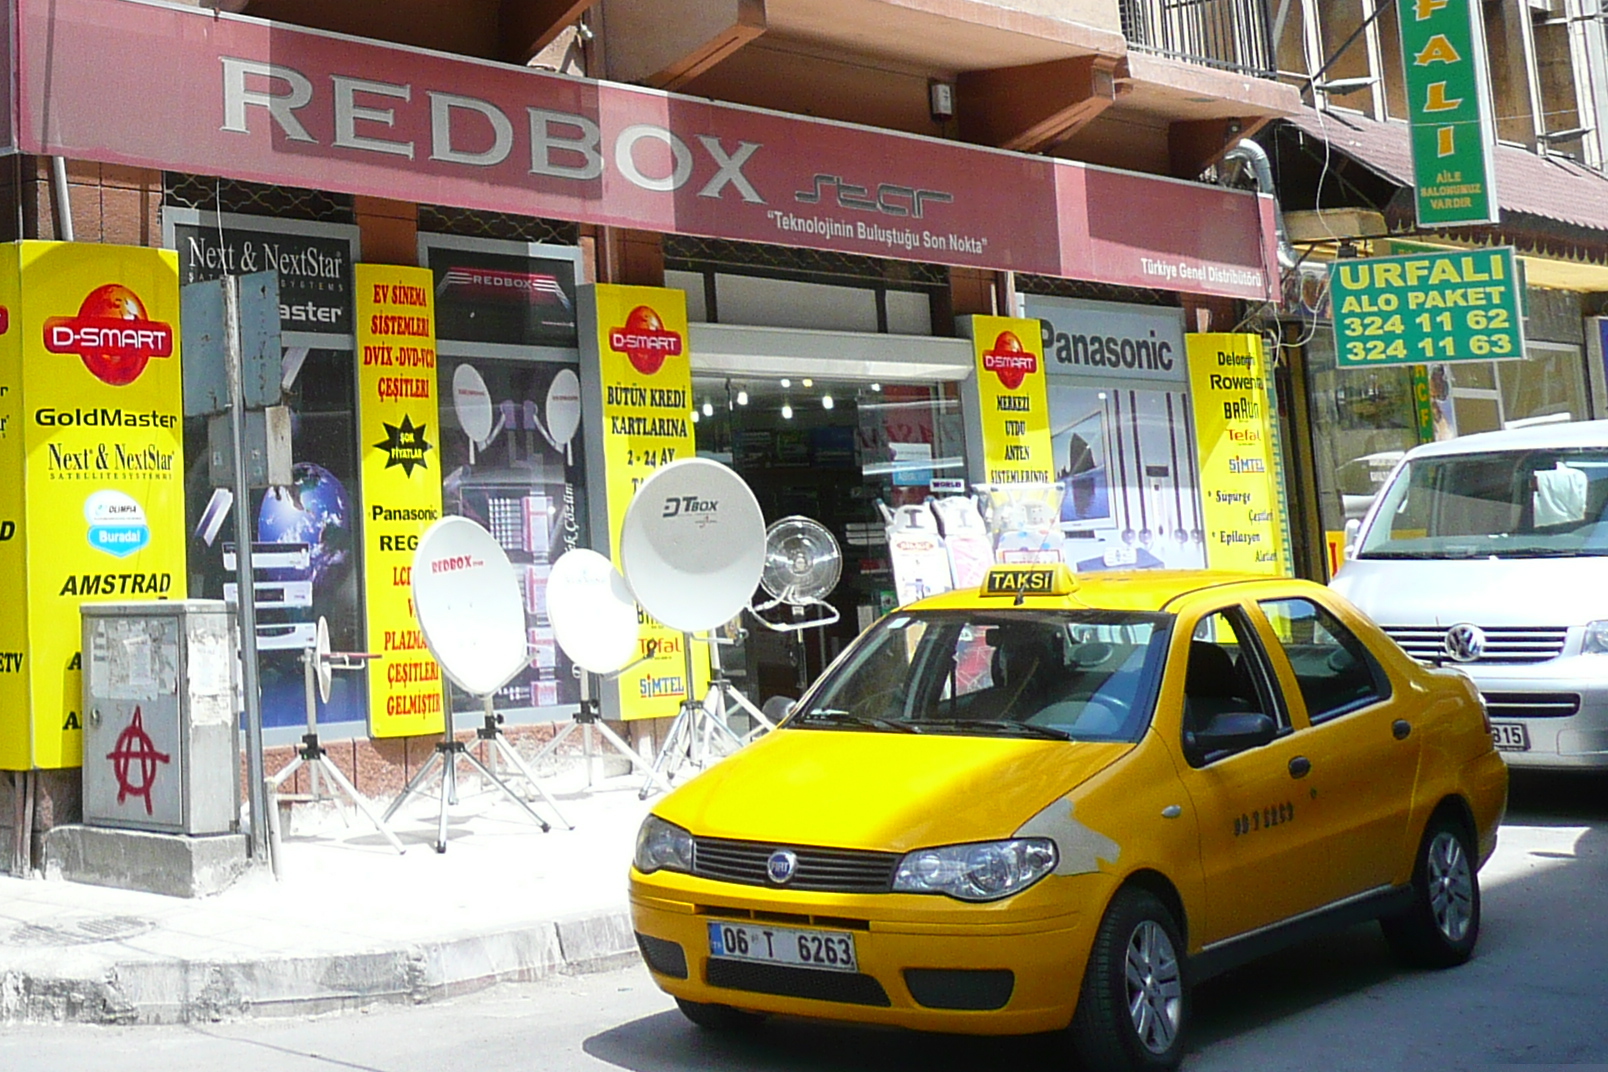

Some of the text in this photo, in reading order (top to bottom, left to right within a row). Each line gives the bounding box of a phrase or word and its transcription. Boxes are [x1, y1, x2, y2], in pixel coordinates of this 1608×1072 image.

[218, 55, 767, 206] REDBOX
[1430, 197, 1473, 209] VARDIR
[857, 221, 921, 250] Buluştuğu
[922, 230, 947, 250] Son
[187, 236, 343, 279] Next & NextStar
[472, 274, 533, 289] REDBOX
[1140, 258, 1263, 287] Türkiye Genel Distribütörü
[1339, 254, 1505, 291] URFALI
[373, 280, 427, 307] EV SİNEMA
[1341, 286, 1506, 314] ALO PAKET
[279, 301, 344, 324] aster
[370, 309, 430, 338] SİSTEMLERİ
[1343, 308, 1510, 337] 324 11 62
[52, 325, 167, 352] D-SMART
[612, 332, 679, 351] D-SMART
[1041, 318, 1174, 371] Panasonic
[1345, 333, 1512, 361] 324 11 63
[363, 340, 394, 366] DVİX
[985, 354, 1034, 371] D-SMART
[377, 373, 430, 403] ÇEŞİTLERİ
[607, 380, 687, 409] BÜTÜN KREDİ
[996, 393, 1030, 412] MERKEZİ
[35, 407, 178, 430] GoldMaster
[611, 415, 688, 438] KARTLARINA
[1227, 428, 1261, 442] Tefal
[48, 442, 175, 472] Next & NextStar
[627, 447, 677, 468] 2 24 AY
[1004, 445, 1030, 461] ANTEN
[990, 466, 1049, 484] SİSTEMLERİNDE
[371, 504, 438, 521] Panasonic
[379, 534, 419, 552] REG
[1220, 531, 1261, 545] Epilasyon
[432, 554, 472, 574] REDBOX
[59, 572, 172, 597] AMSTRAD
[383, 629, 428, 651] PLAZMA
[386, 688, 441, 720] GELMİŞTİR
[723, 927, 852, 965] 06 T 6263
